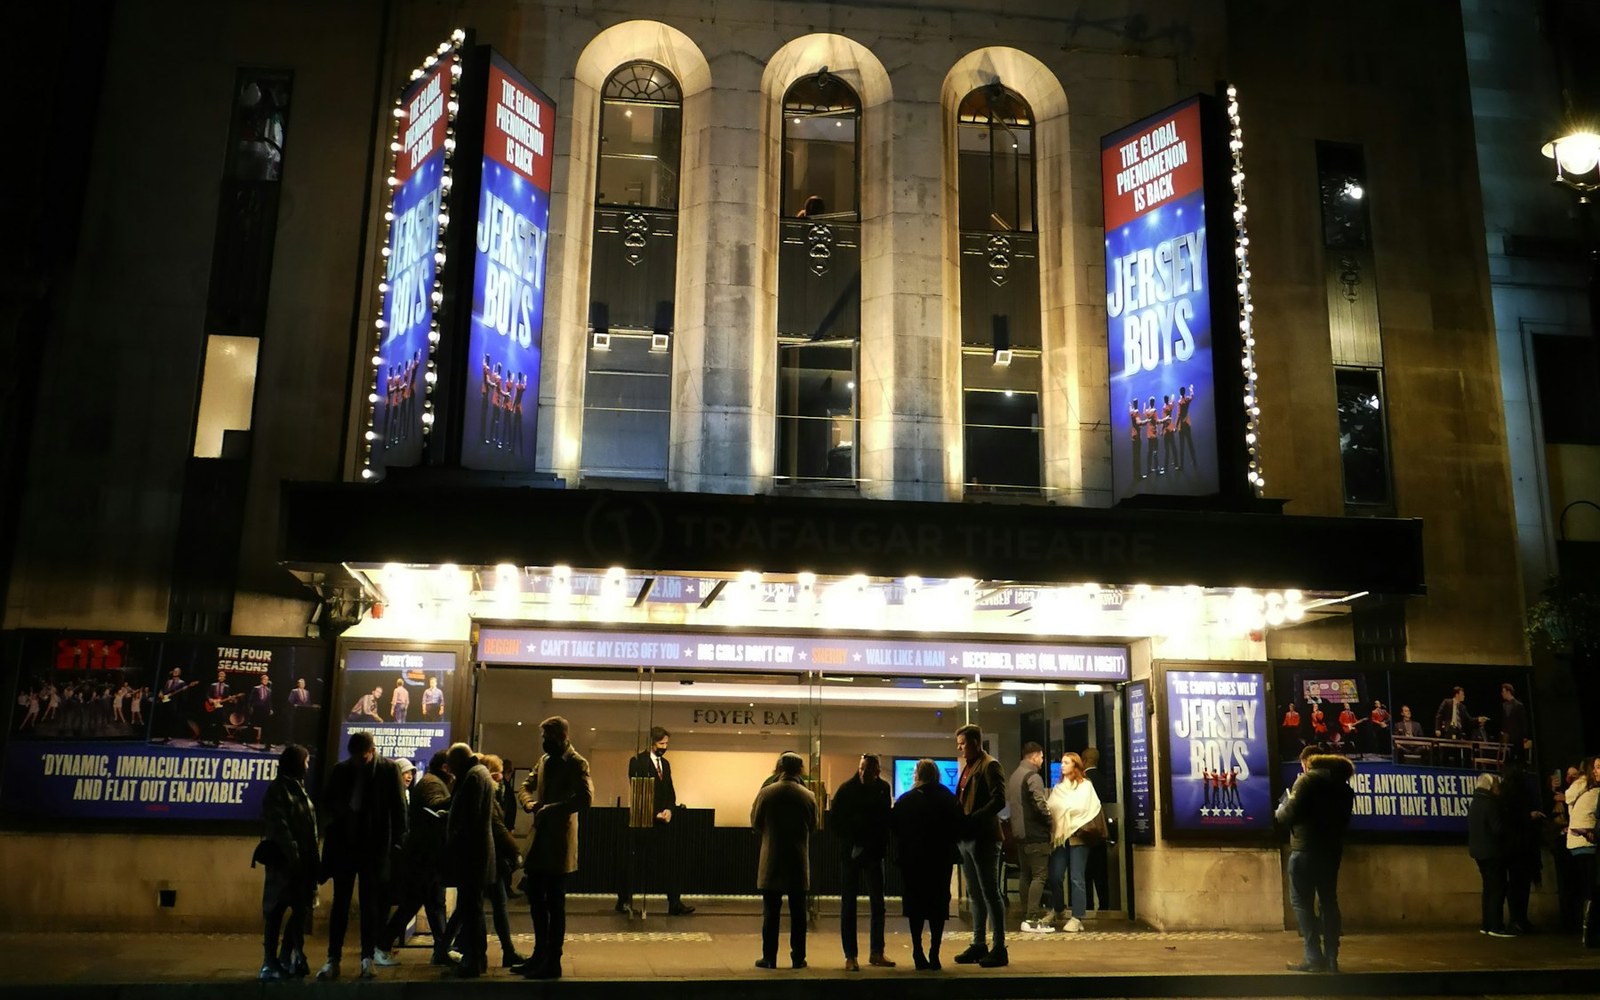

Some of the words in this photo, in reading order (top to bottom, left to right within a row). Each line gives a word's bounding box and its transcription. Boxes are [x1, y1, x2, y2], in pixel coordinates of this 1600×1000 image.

[502, 78, 516, 111] THE
[516, 90, 540, 128] GLOBAL
[496, 102, 544, 157] PHENOMENON
[1120, 139, 1140, 168] THE
[1140, 120, 1180, 154] GLOBAL
[506, 136, 514, 164] IS
[514, 142, 533, 176] BACK
[1116, 140, 1188, 196] PHENOMENON
[1134, 188, 1146, 212] IS
[1146, 172, 1175, 207] BACK
[387, 186, 442, 282] JERSEY
[476, 189, 547, 290] JERSEY
[1106, 229, 1206, 318] JERSEY
[388, 257, 430, 341] BOYS
[482, 258, 533, 349] BOYS
[1124, 299, 1195, 377] BOYS
[676, 515, 945, 558] TRAFALGAR
[956, 525, 1155, 566] THEATRE
[217, 647, 240, 658] THE
[241, 648, 272, 661] FOUR
[218, 660, 268, 672] SEASONS
[540, 639, 570, 657] CAN'T
[571, 640, 595, 658] TAKE
[596, 641, 612, 658] MY
[614, 642, 638, 659] EYES
[640, 642, 658, 659] OFF
[660, 642, 680, 660] YOU
[715, 644, 744, 662] GIRLS
[744, 644, 774, 663] DON'T
[774, 645, 796, 664] CRY
[865, 648, 890, 665] WALK
[893, 649, 913, 666] LIKE
[914, 650, 922, 666] A
[924, 650, 946, 668] MAN
[1058, 653, 1085, 672] WHAT
[1086, 655, 1094, 672] A
[693, 709, 756, 725] FOYER
[1174, 699, 1258, 740] JERSEY
[42, 754, 112, 778] 'DYNAMIC,
[115, 756, 220, 779] IMMACULATELY
[221, 758, 280, 781] CRAFTED
[1190, 738, 1249, 781] BOYS
[73, 778, 102, 801] AND
[104, 780, 138, 802] FLAT
[140, 780, 167, 802] OUT
[168, 781, 249, 804] ENJOYABLE'
[1374, 773, 1418, 794] ANYONE
[1420, 774, 1436, 795] TO
[1437, 774, 1458, 795] SEE
[1351, 795, 1372, 815] AND
[1375, 796, 1397, 816] NOT
[1400, 796, 1428, 816] HAVE
[1430, 796, 1438, 816] A
